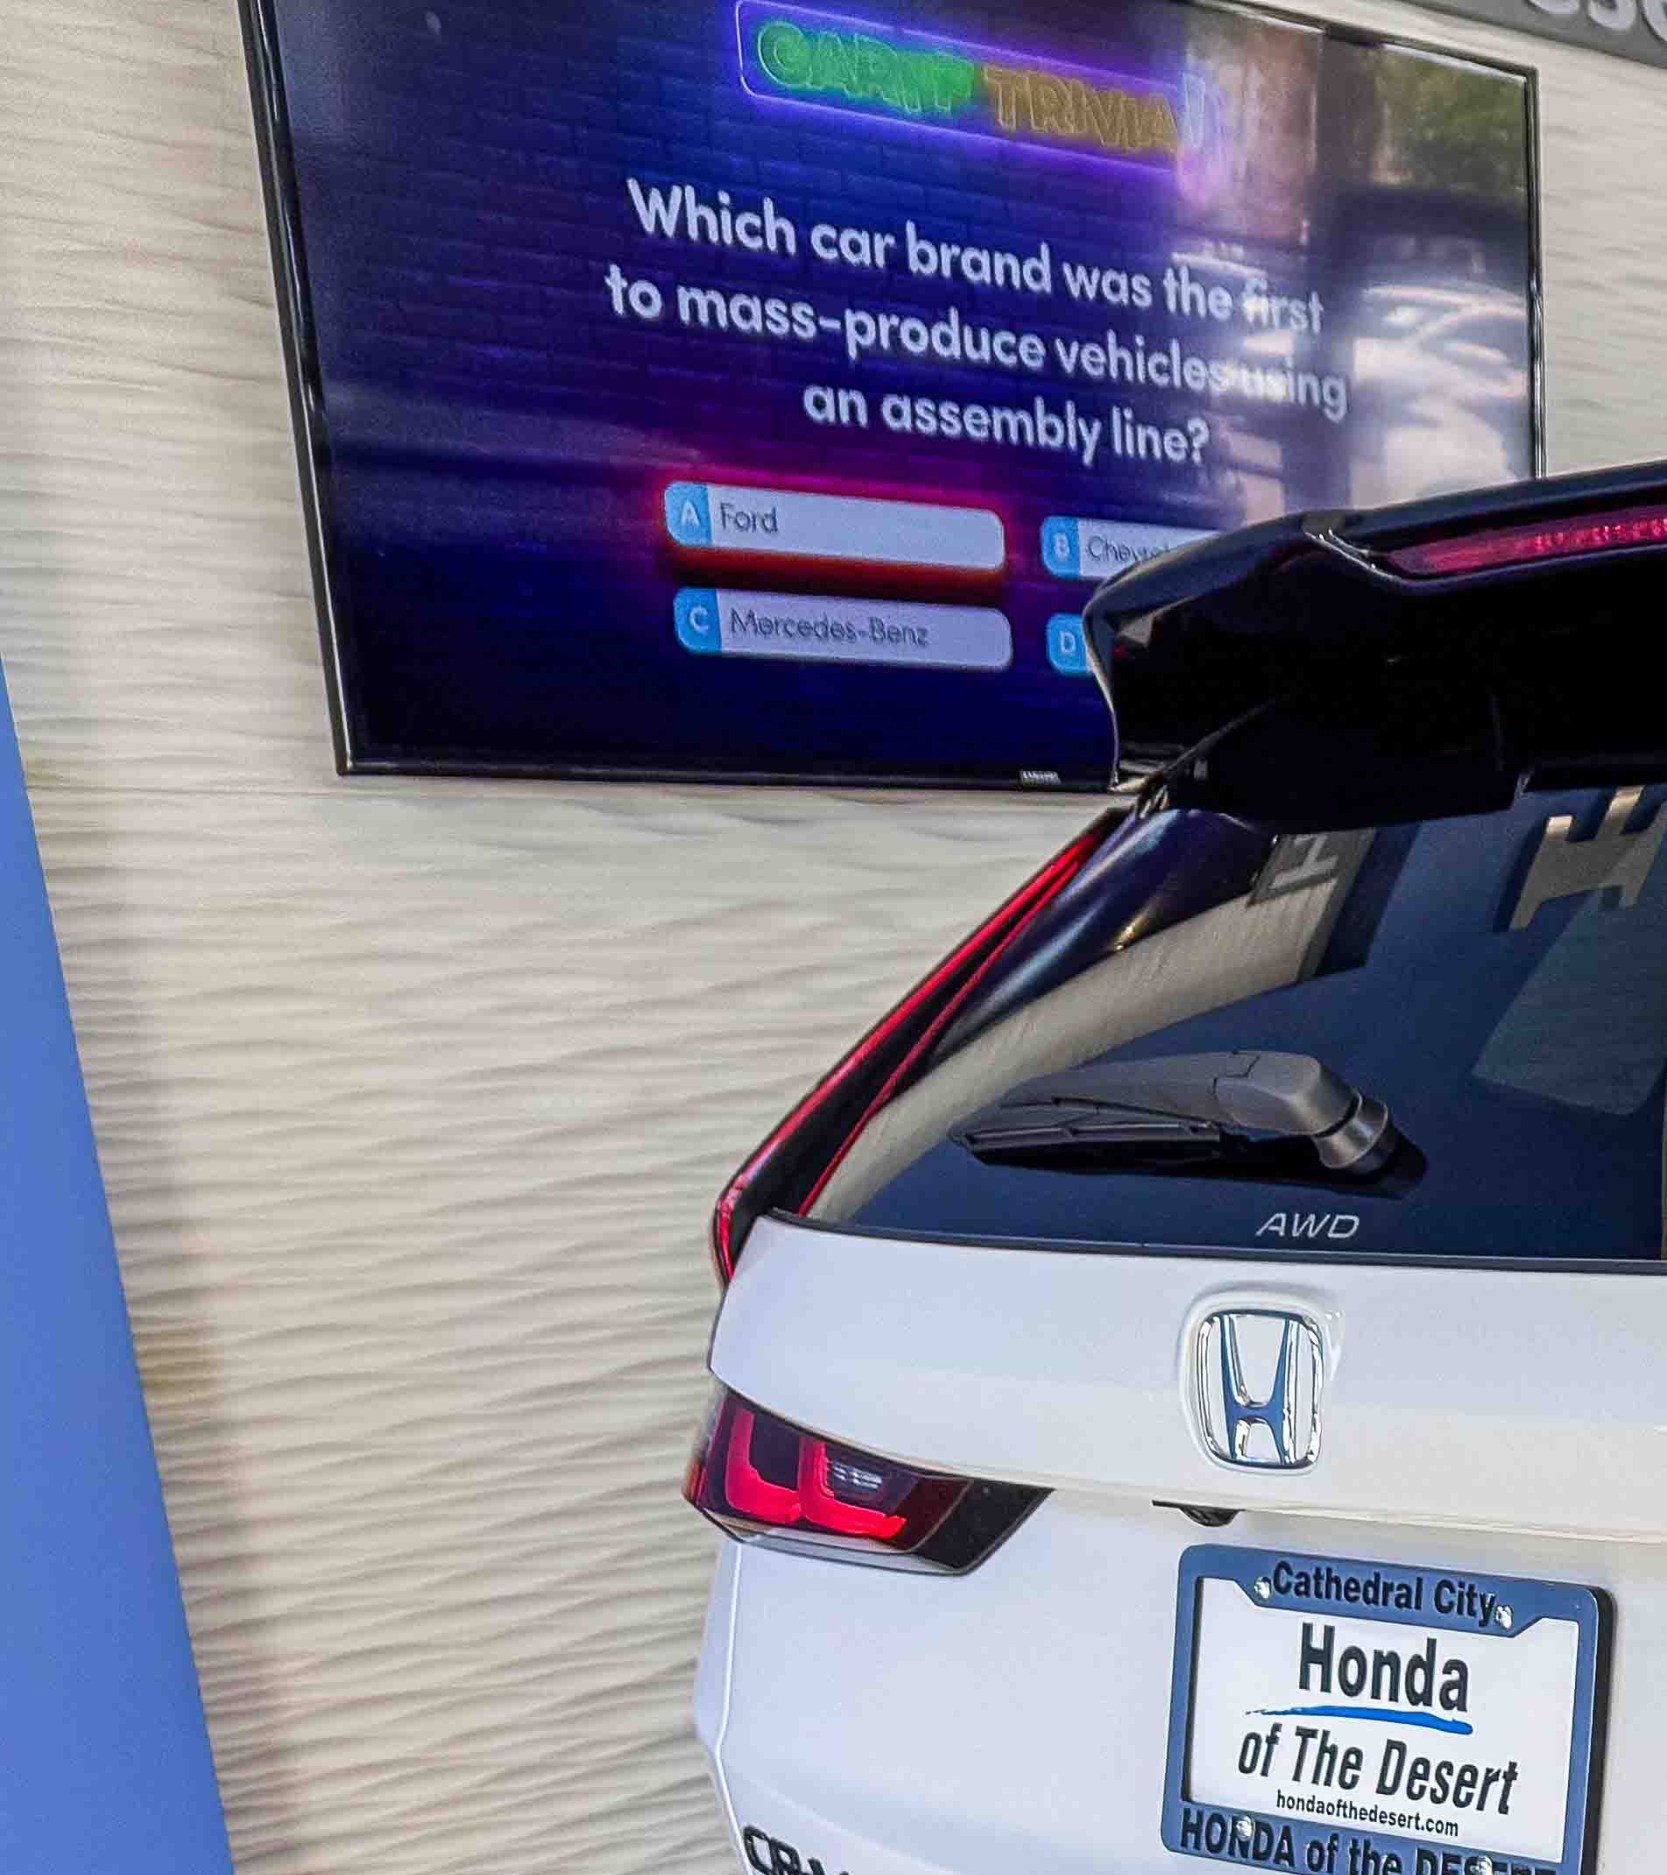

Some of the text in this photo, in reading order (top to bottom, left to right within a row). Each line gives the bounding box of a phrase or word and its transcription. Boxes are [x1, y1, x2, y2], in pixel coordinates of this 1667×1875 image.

[627, 178, 1324, 335] Which car brand was the first
[605, 264, 663, 319] to
[677, 284, 1047, 369] mass-produce
[1054, 329, 1232, 393] vehicles
[803, 384, 1211, 467] an assembly line?
[679, 501, 779, 535] A Ford
[1053, 532, 1071, 561] B
[688, 606, 929, 648] C Mercedes-Benz
[1059, 630, 1077, 653] D
[1256, 1213, 1360, 1238] AWD
[1273, 1560, 1496, 1628] Cathedral City
[1299, 1622, 1471, 1713] Honda
[1238, 1723, 1519, 1815] of The Desert
[1180, 1808, 1296, 1868] HONDA
[1306, 1832, 1339, 1875] of
[1276, 1789, 1459, 1838] hondaofthedesert.com
